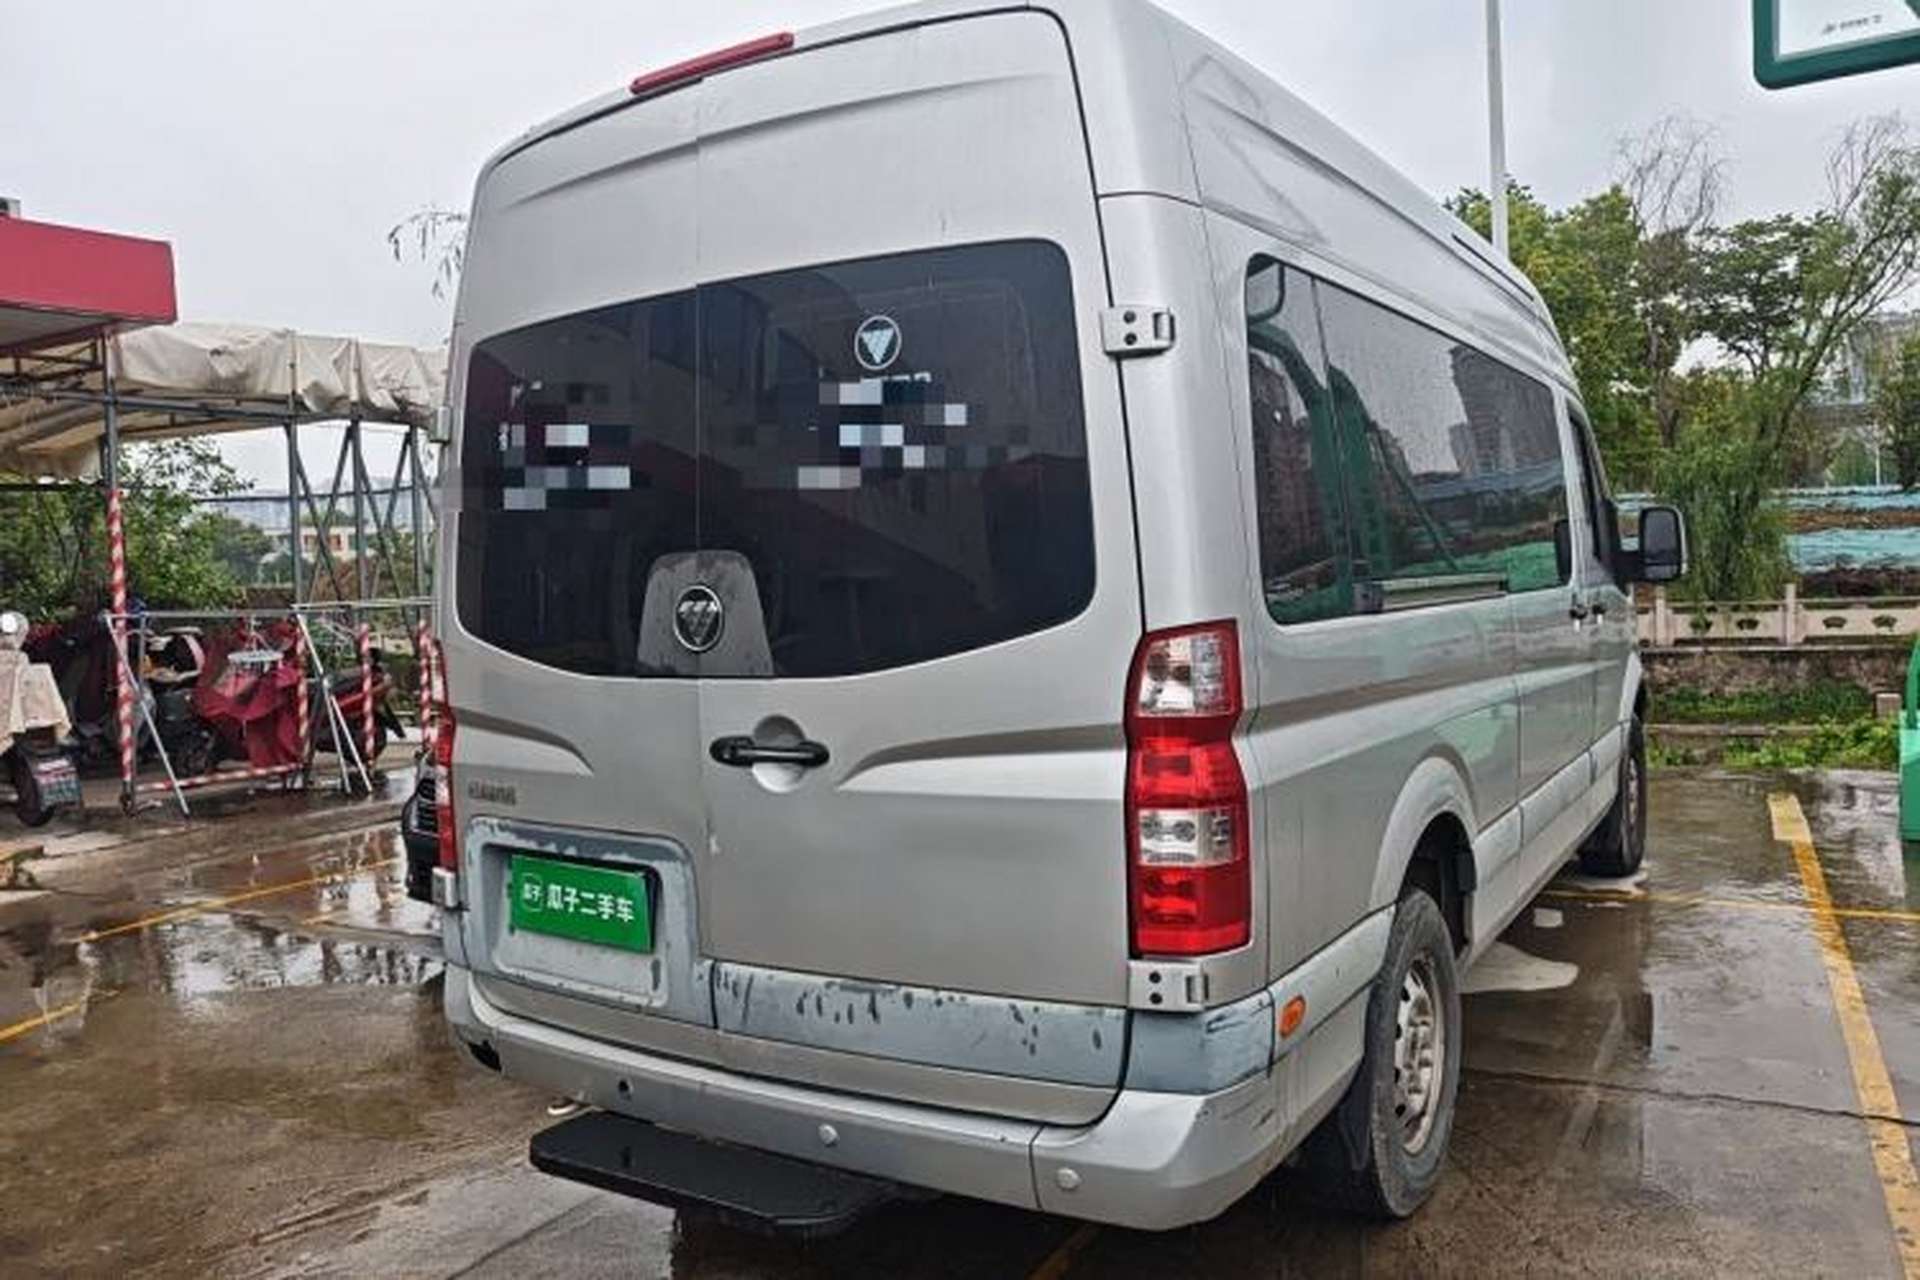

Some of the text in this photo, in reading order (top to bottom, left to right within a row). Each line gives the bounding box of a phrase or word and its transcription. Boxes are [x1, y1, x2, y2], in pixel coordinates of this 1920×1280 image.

[547, 883, 635, 923] 瓜子二手车
